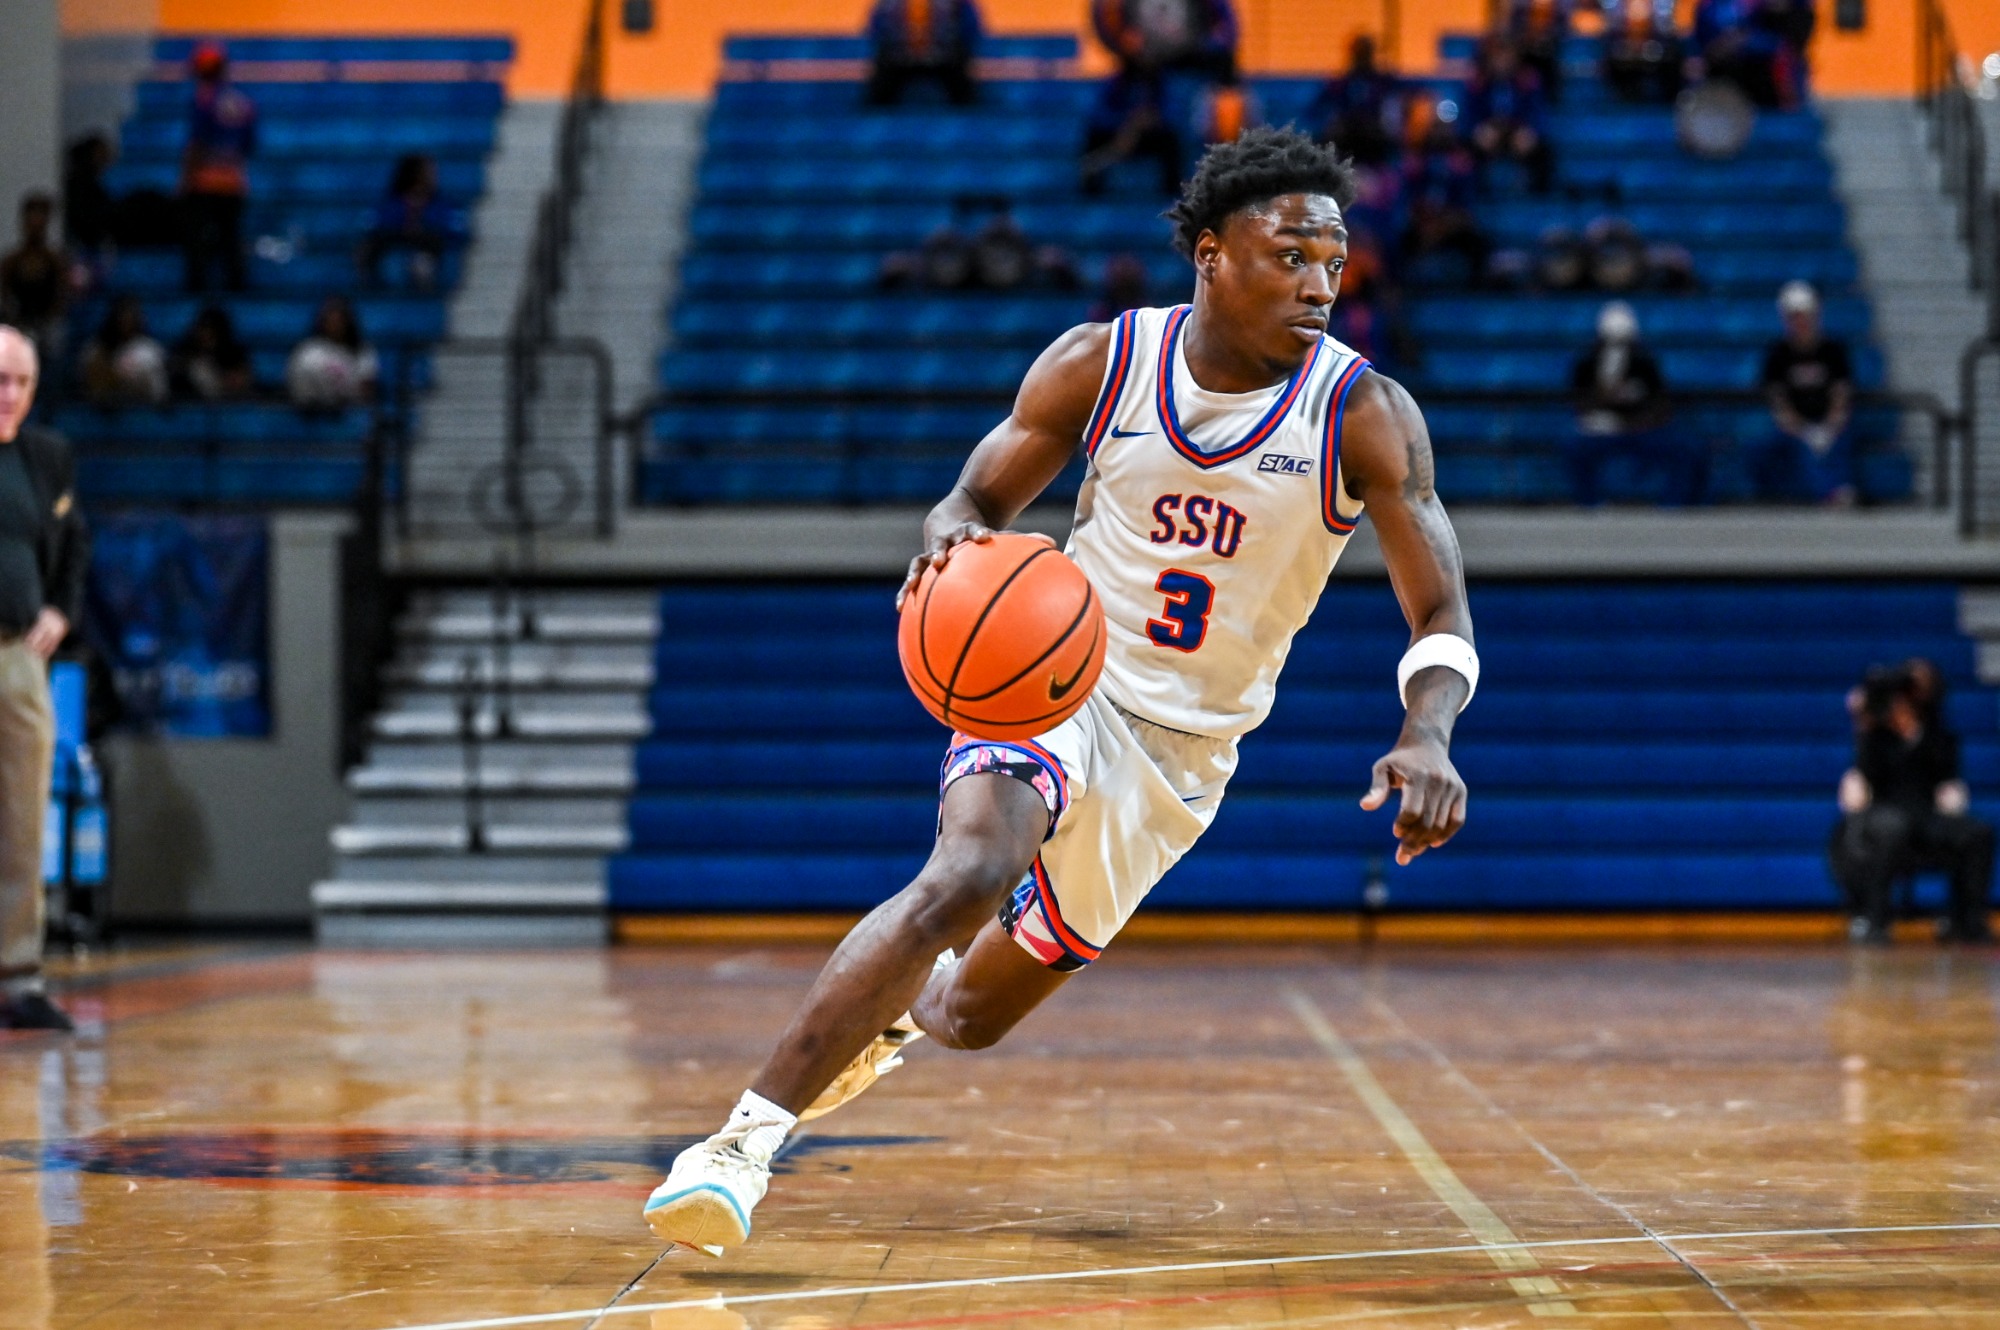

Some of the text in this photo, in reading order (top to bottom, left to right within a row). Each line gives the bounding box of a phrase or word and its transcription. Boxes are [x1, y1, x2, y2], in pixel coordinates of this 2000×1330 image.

[1259, 455, 1312, 474] SIAC
[1150, 493, 1248, 559] SSU
[1145, 567, 1216, 653] 3
